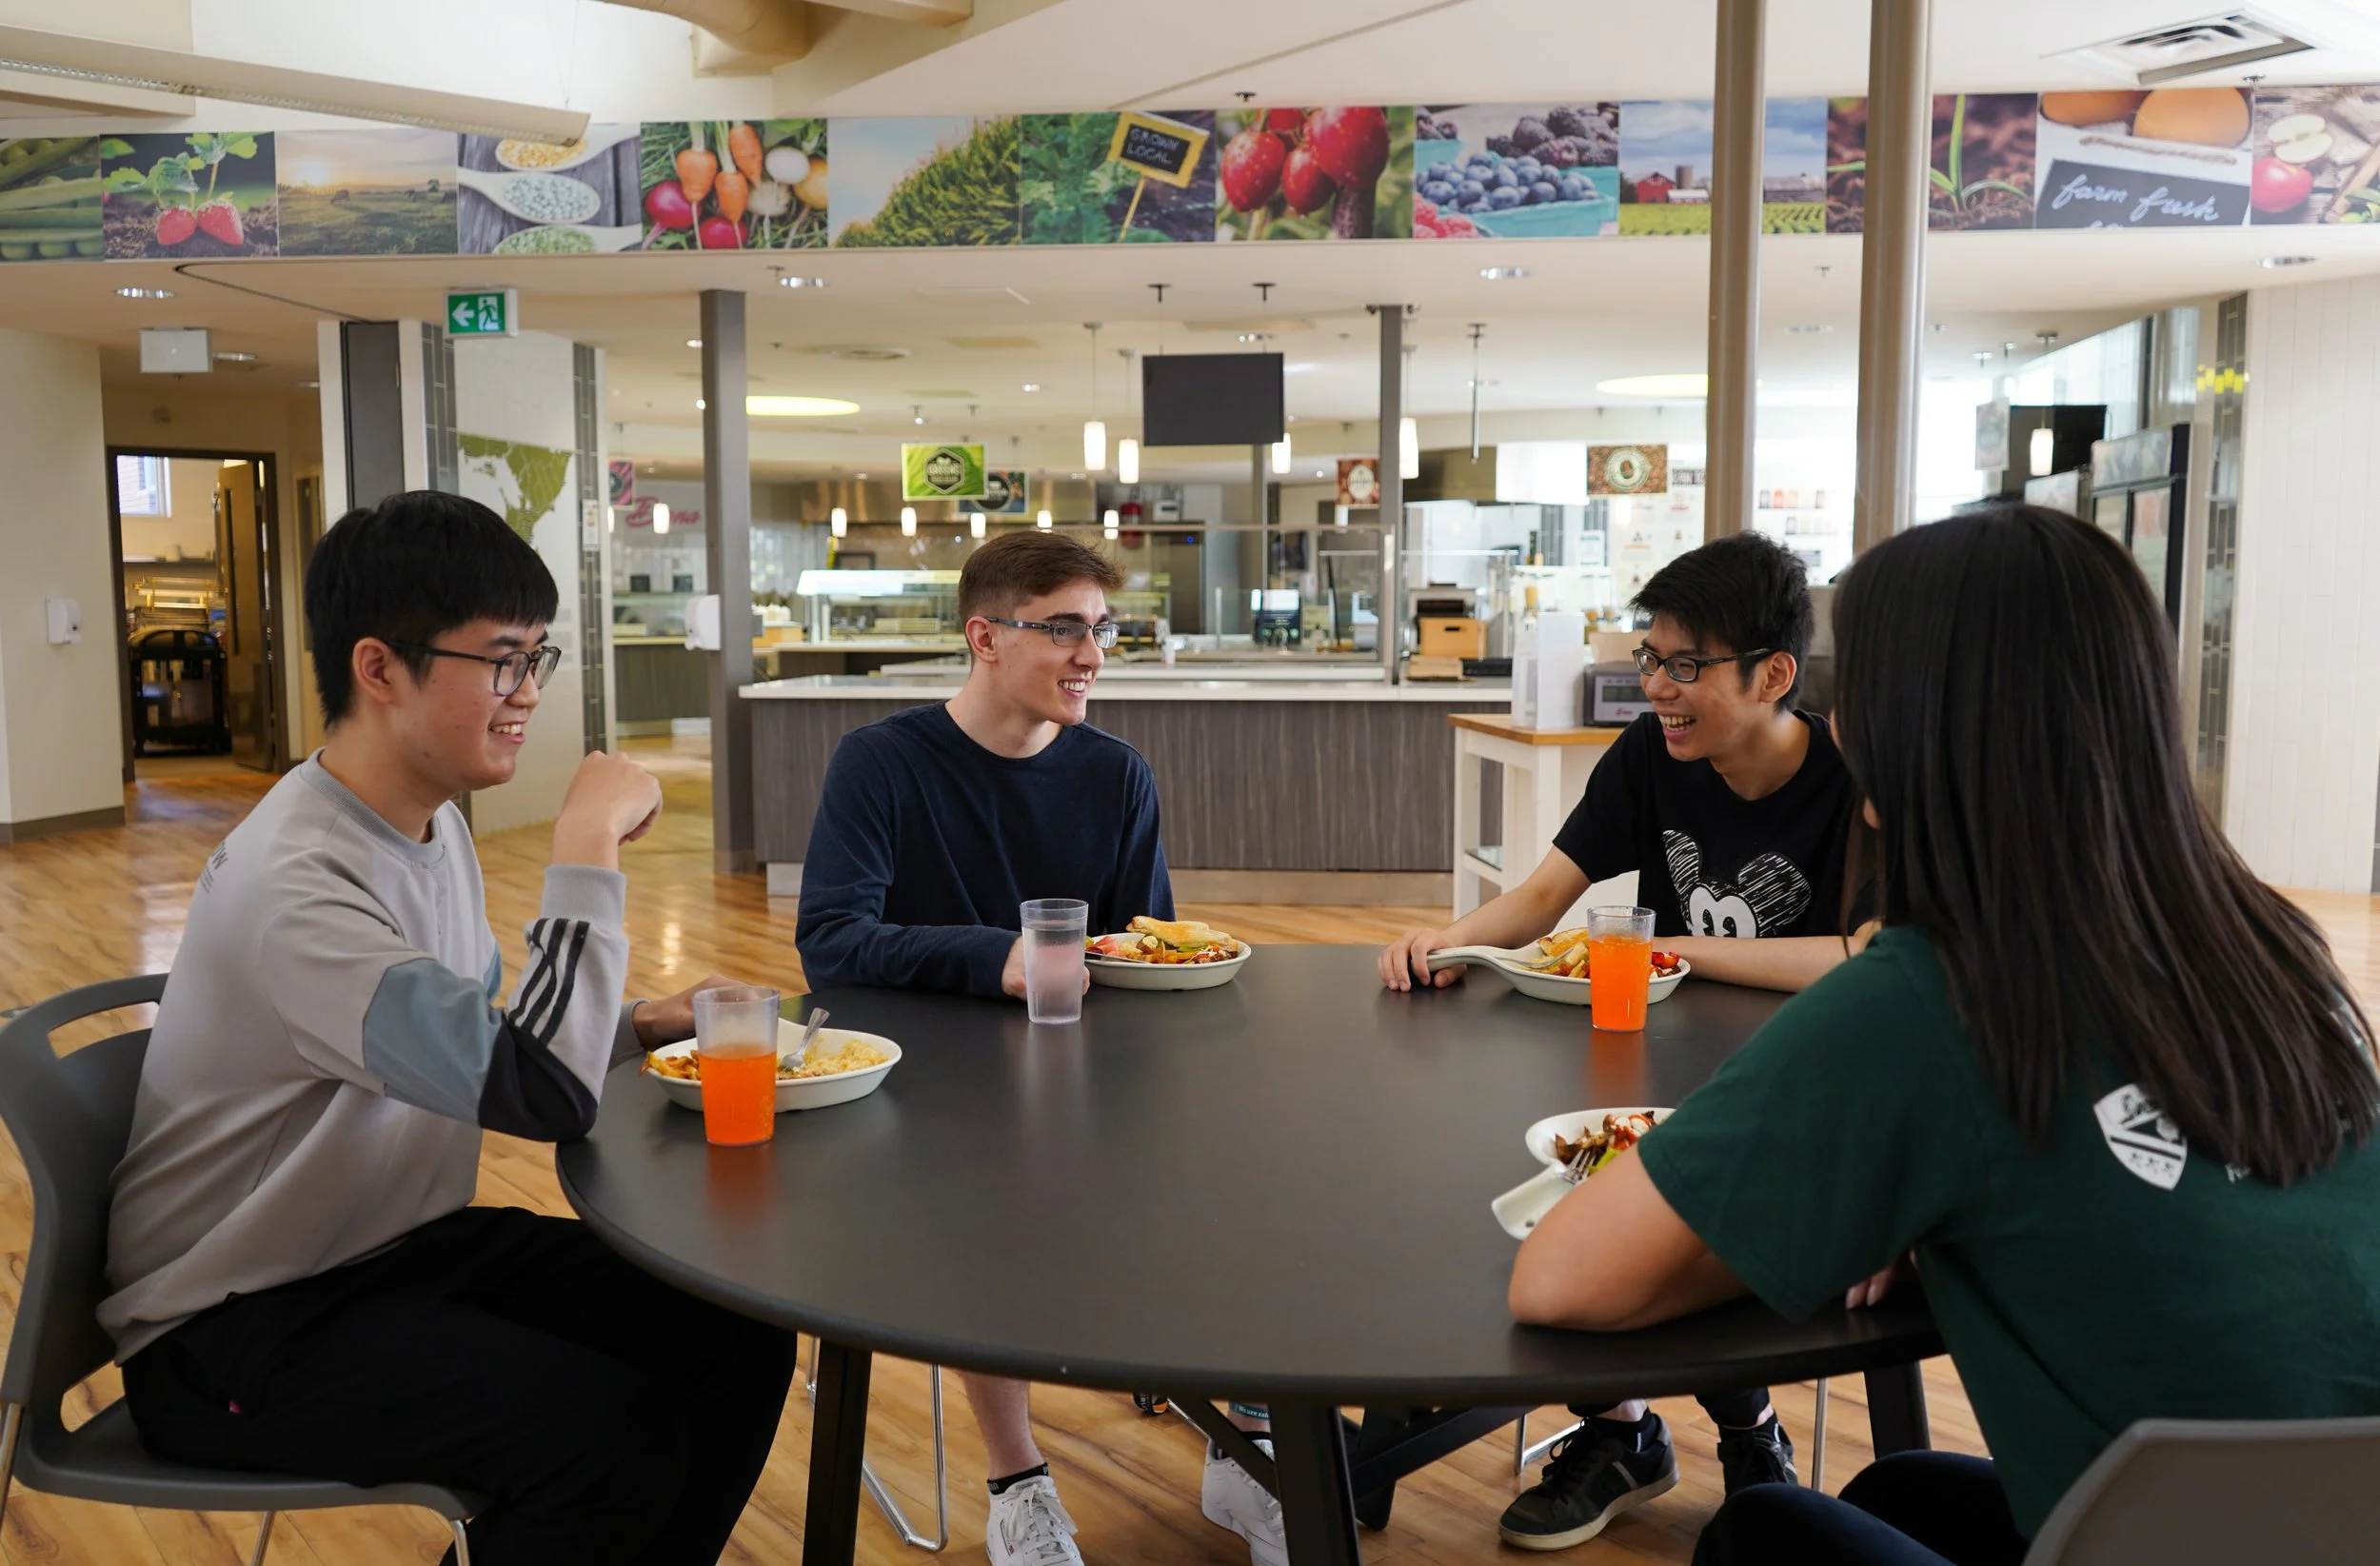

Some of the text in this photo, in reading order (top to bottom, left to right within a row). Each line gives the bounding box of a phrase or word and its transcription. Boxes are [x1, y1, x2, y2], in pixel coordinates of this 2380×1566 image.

[1129, 128, 1180, 150] GROWN
[1126, 142, 1173, 165] LOCAL
[2052, 173, 2129, 210] farm
